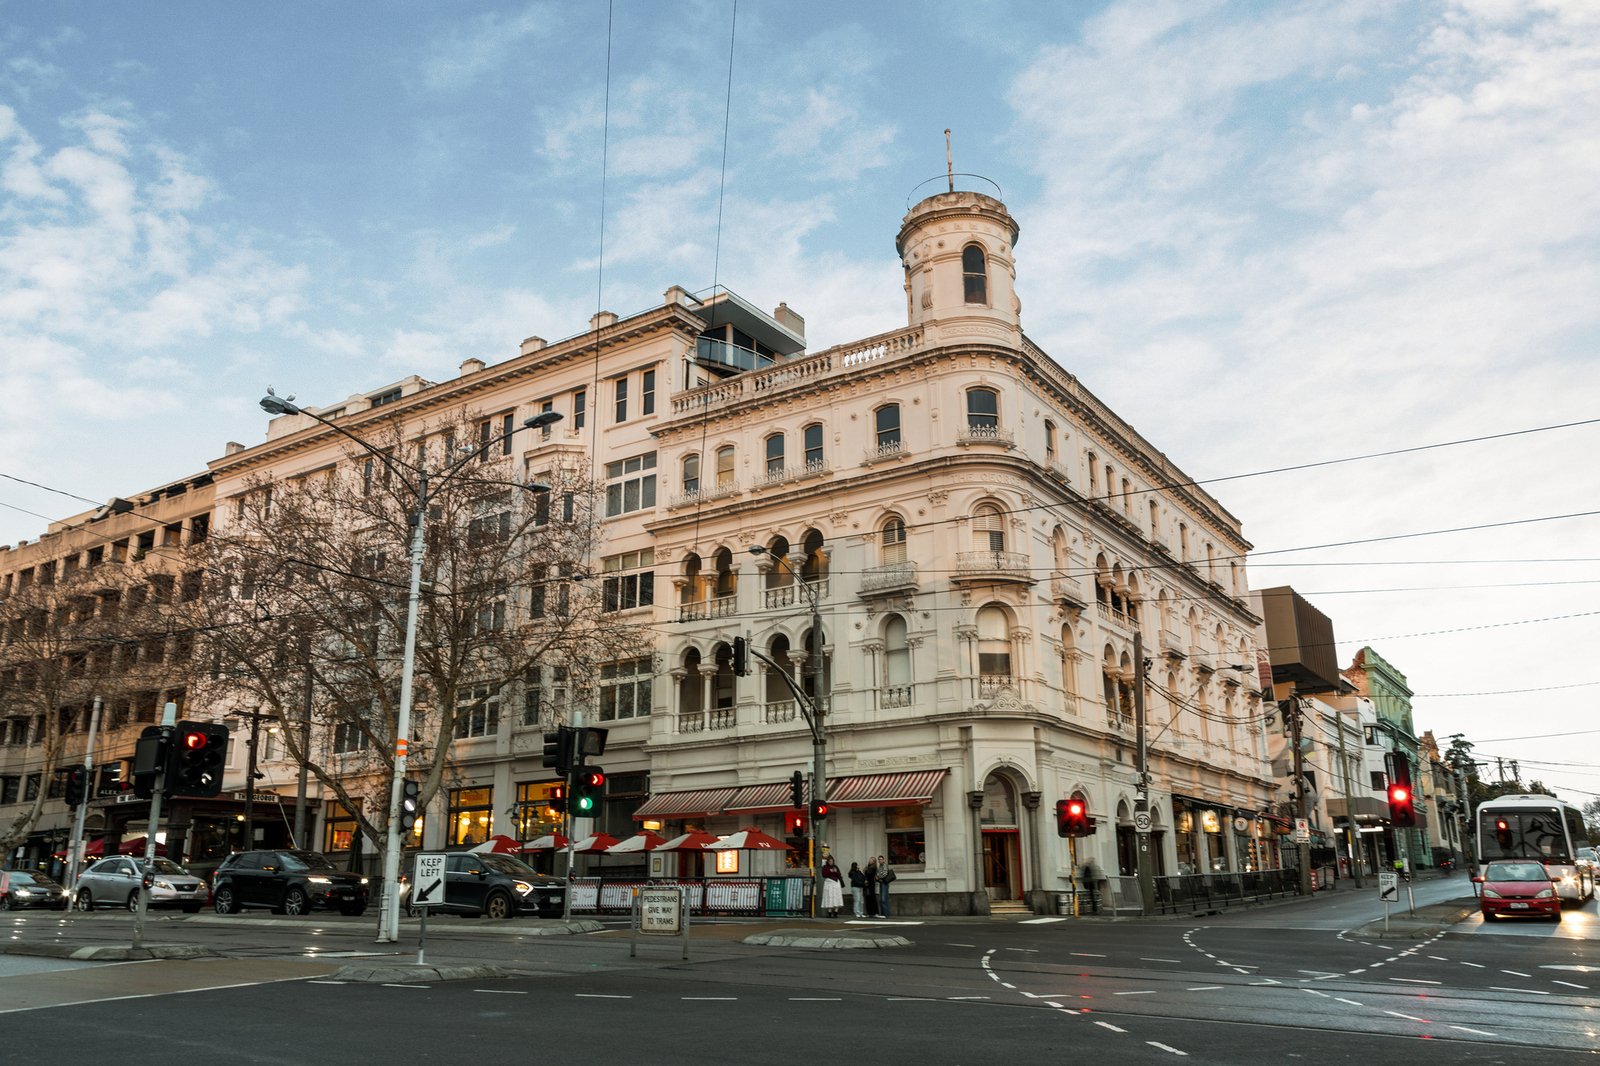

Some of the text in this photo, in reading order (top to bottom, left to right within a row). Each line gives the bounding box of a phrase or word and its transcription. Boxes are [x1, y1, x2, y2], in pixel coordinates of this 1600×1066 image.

[421, 858, 442, 867] KEEP
[421, 869, 440, 877] LEFT
[648, 917, 674, 925] TO TRAMS
